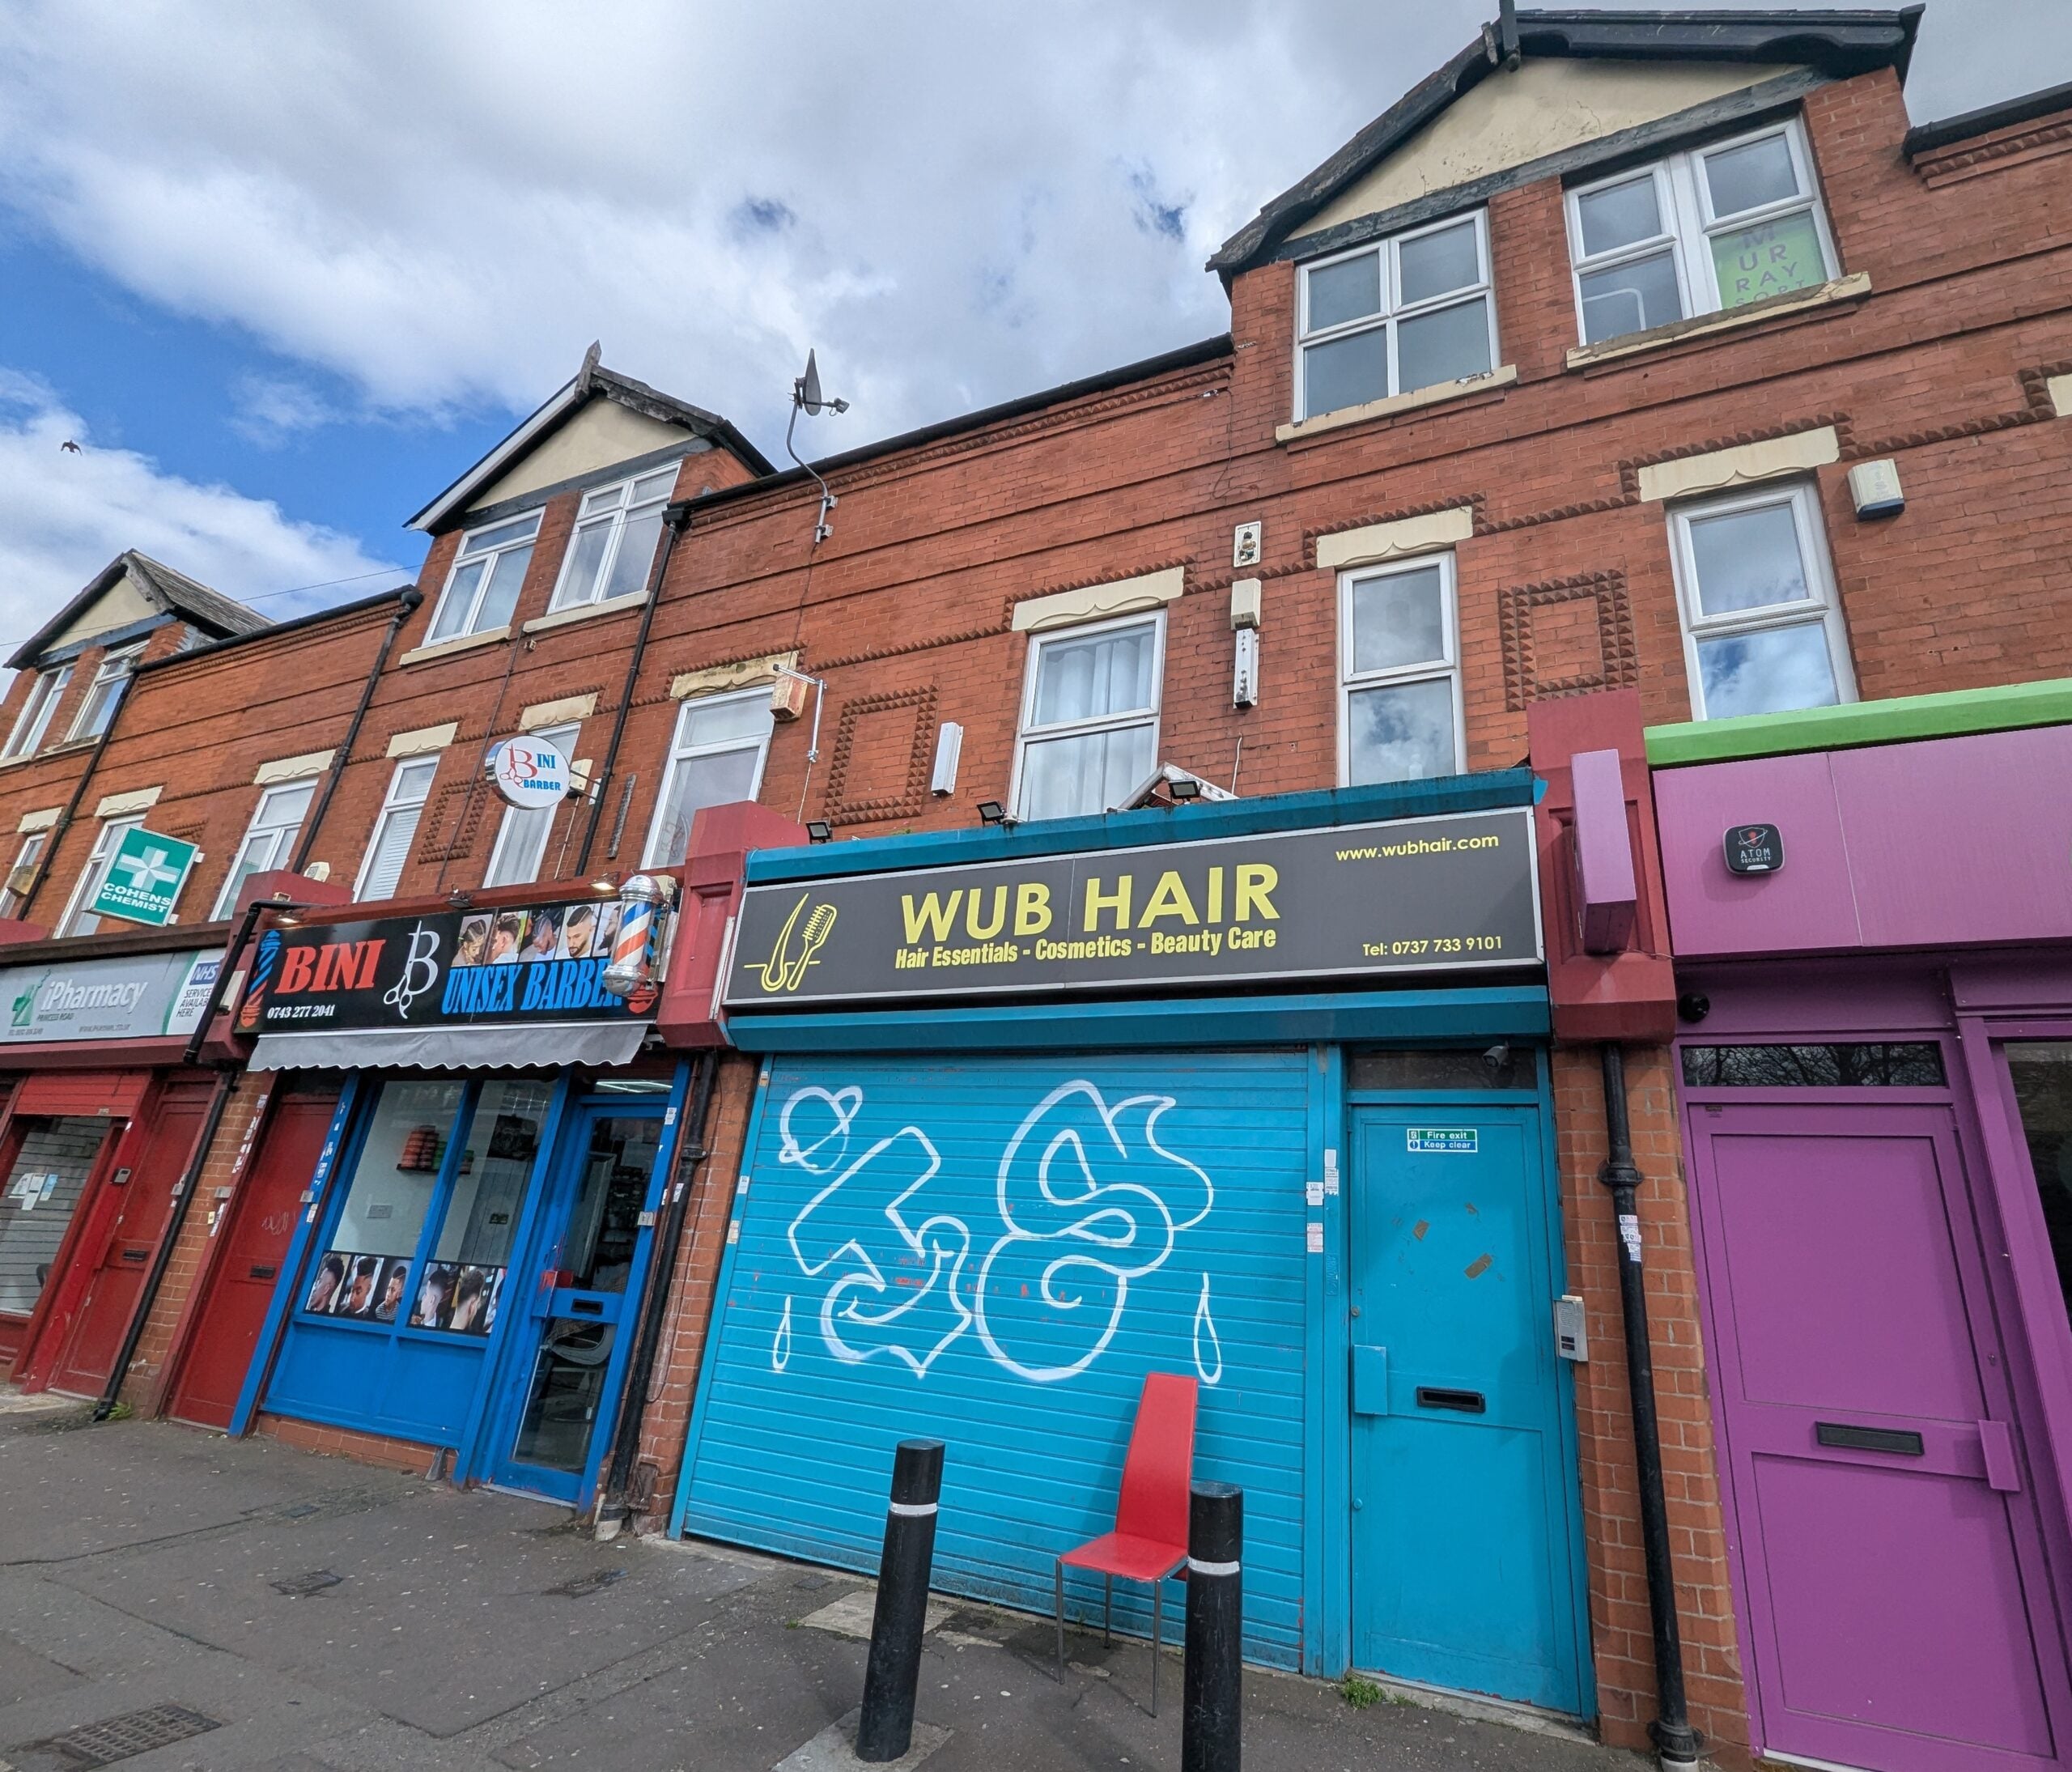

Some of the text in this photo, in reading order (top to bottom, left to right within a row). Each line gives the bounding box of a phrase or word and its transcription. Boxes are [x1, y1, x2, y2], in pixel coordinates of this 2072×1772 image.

[523, 779, 561, 791] BARBER
[1335, 835, 1499, 861] www.wubhair.com
[1740, 848, 1771, 858] ATOM
[101, 891, 168, 913] CHEMIST
[104, 882, 172, 906] COHENS
[901, 863, 1280, 944] WUB HAIR
[895, 947, 929, 969] Hair
[932, 941, 1018, 967] Essentials
[1035, 936, 1132, 961] Cosmetics
[1151, 929, 1222, 956] Beauty
[1228, 927, 1276, 950] Care
[1363, 936, 1501, 956] Tel: 0737 733 9101
[193, 965, 220, 981] NHS
[274, 939, 386, 994] BINI
[441, 958, 622, 1013] UNISEX BARBE
[41, 979, 148, 1014] iPharmacy
[180, 998, 209, 1008] AVAILAB
[176, 1008, 194, 1017] HERE
[267, 1004, 335, 1019] 0743 277 2041
[1424, 1141, 1446, 1149] Keep
[1427, 1131, 1467, 1139] Fire exit
